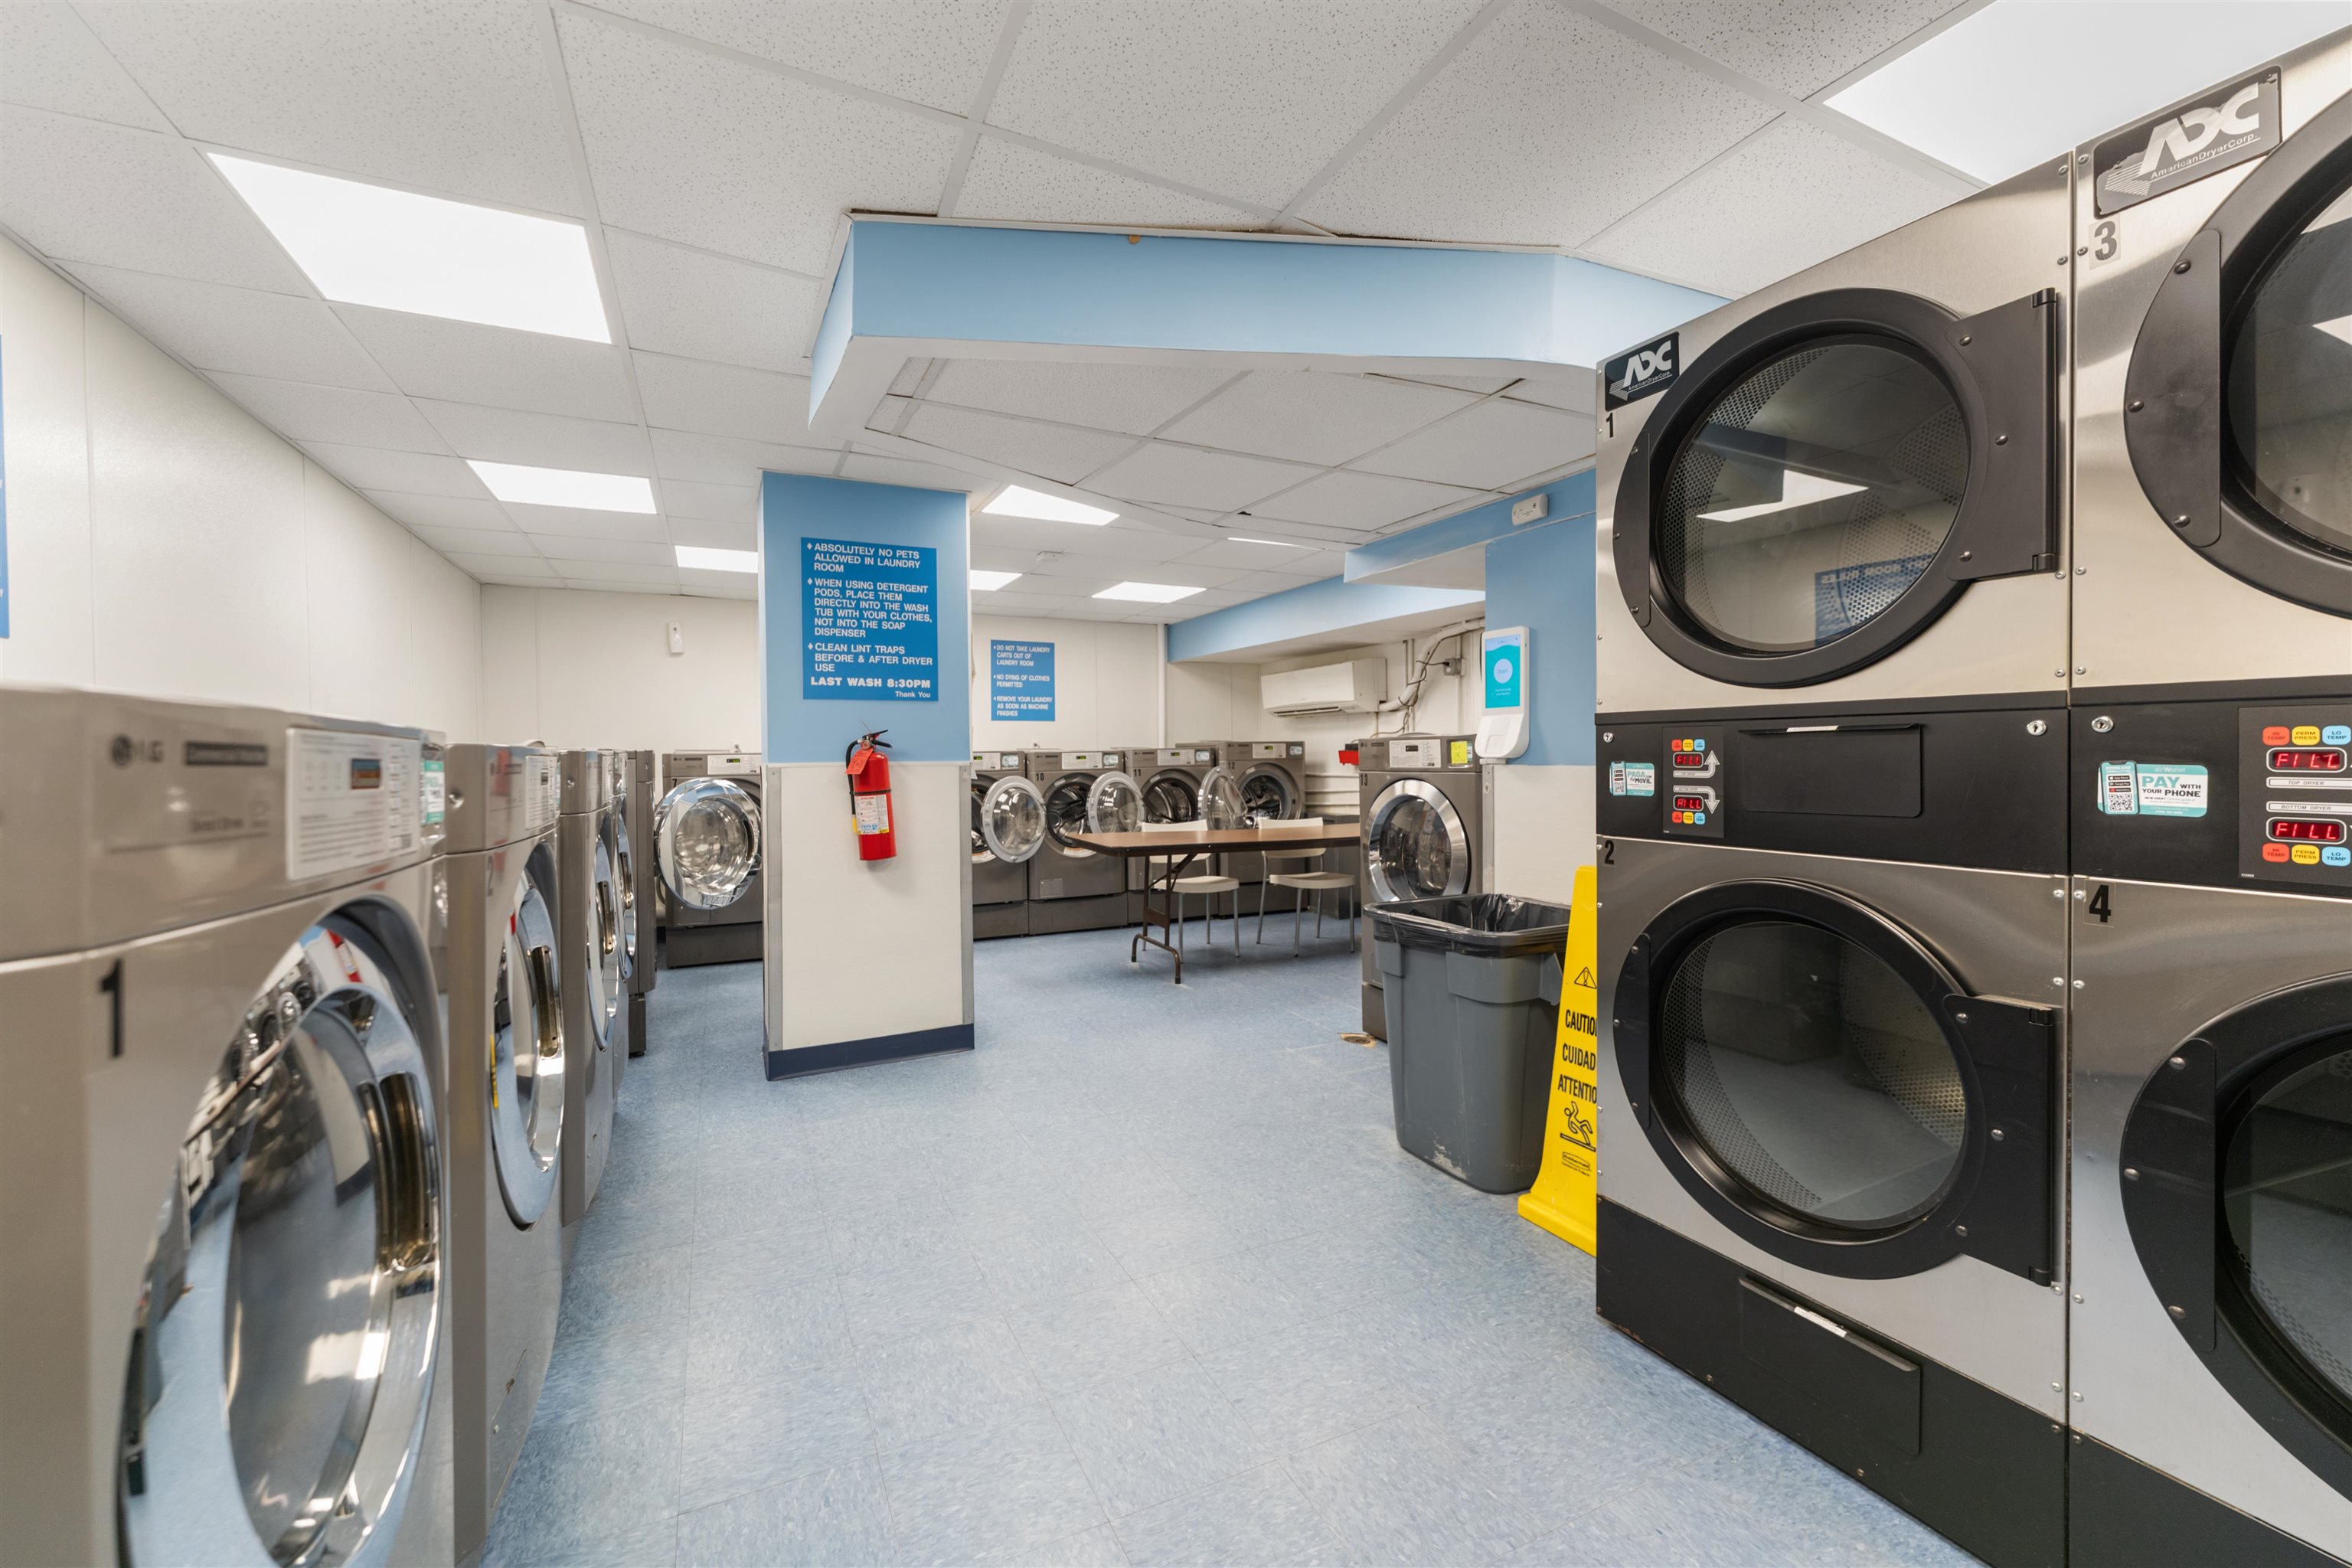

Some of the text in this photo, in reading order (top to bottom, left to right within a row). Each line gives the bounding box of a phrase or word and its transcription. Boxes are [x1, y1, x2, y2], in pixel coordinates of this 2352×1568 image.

[2139, 82, 2259, 175] ADC
[2151, 133, 2260, 180] AmericanDryerCorp.
[2094, 221, 2118, 261] 3
[1623, 340, 1672, 387] ADC
[1628, 371, 1671, 390] AmericanDryerCorp.
[1606, 413, 1614, 438] 1
[815, 543, 874, 555] ABSOLUTELY
[897, 550, 920, 559] PETS
[815, 553, 861, 564] ALLOWED
[877, 558, 920, 568] LAUNDRY
[815, 563, 844, 572] ROOM
[815, 578, 928, 593] WHEN USING DETERGENT
[815, 588, 902, 601] PODS, PLACE THEM
[815, 598, 928, 612] DIRECTLY INTO THE WASH
[815, 608, 932, 623] TUB WITH YOUR CLOTHES,
[815, 618, 833, 626] NOT
[861, 620, 877, 629] THE
[882, 621, 906, 629] SOAP
[815, 628, 866, 638] DISPENSER
[815, 643, 847, 652] CLEAN
[875, 645, 905, 654] TRAPS
[815, 654, 854, 662] BEFORE
[869, 655, 898, 664] AFTER
[903, 657, 933, 665] DRYER
[811, 678, 930, 688] LAST WASH 8:30PM
[1677, 756, 1700, 765] FILL
[2276, 753, 2338, 769] FILL
[672, 779, 677, 787] 7
[1361, 774, 1367, 786] 13
[2142, 776, 2180, 788] PAY
[2275, 823, 2336, 840] FILL
[1604, 841, 1615, 864] 2
[487, 855, 493, 896] 2
[2089, 885, 2111, 923] 4
[100, 959, 123, 1057] 1
[1565, 1009, 1597, 1037] CAUTIO
[1563, 1044, 1596, 1071] CUIDAD
[1558, 1074, 1597, 1104] ATTENTIO
